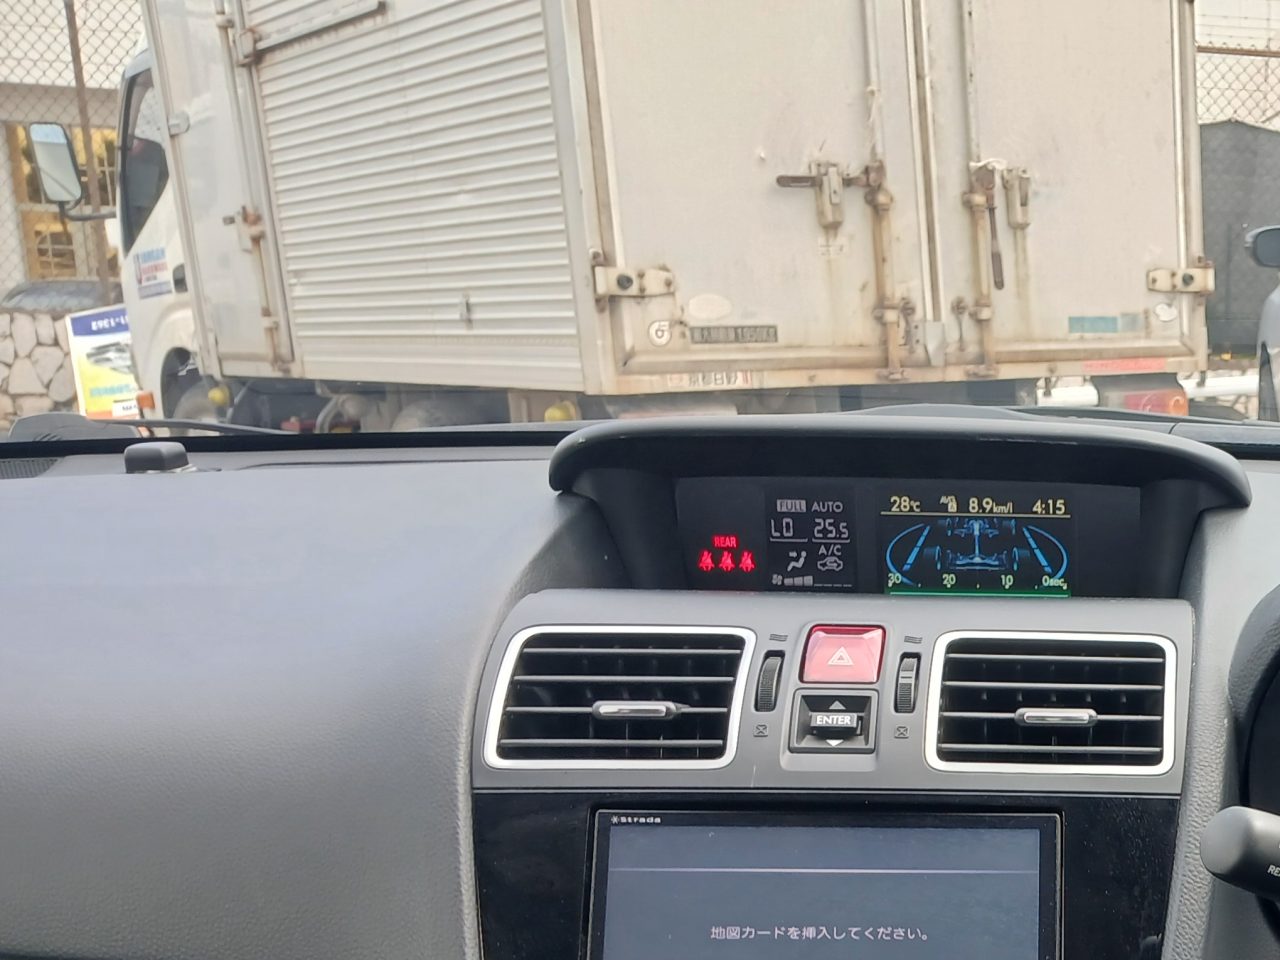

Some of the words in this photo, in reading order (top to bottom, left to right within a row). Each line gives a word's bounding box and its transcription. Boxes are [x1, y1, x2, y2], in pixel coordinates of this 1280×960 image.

[777, 499, 807, 512] FULL
[811, 501, 843, 512] AUTO
[1032, 500, 1066, 515] 4:15
[813, 518, 849, 538] 25.5
[714, 535, 737, 548] REAR
[818, 544, 842, 556] A/C
[942, 574, 957, 586] 20
[1000, 575, 1014, 586] 10
[816, 715, 851, 725] ENTER
